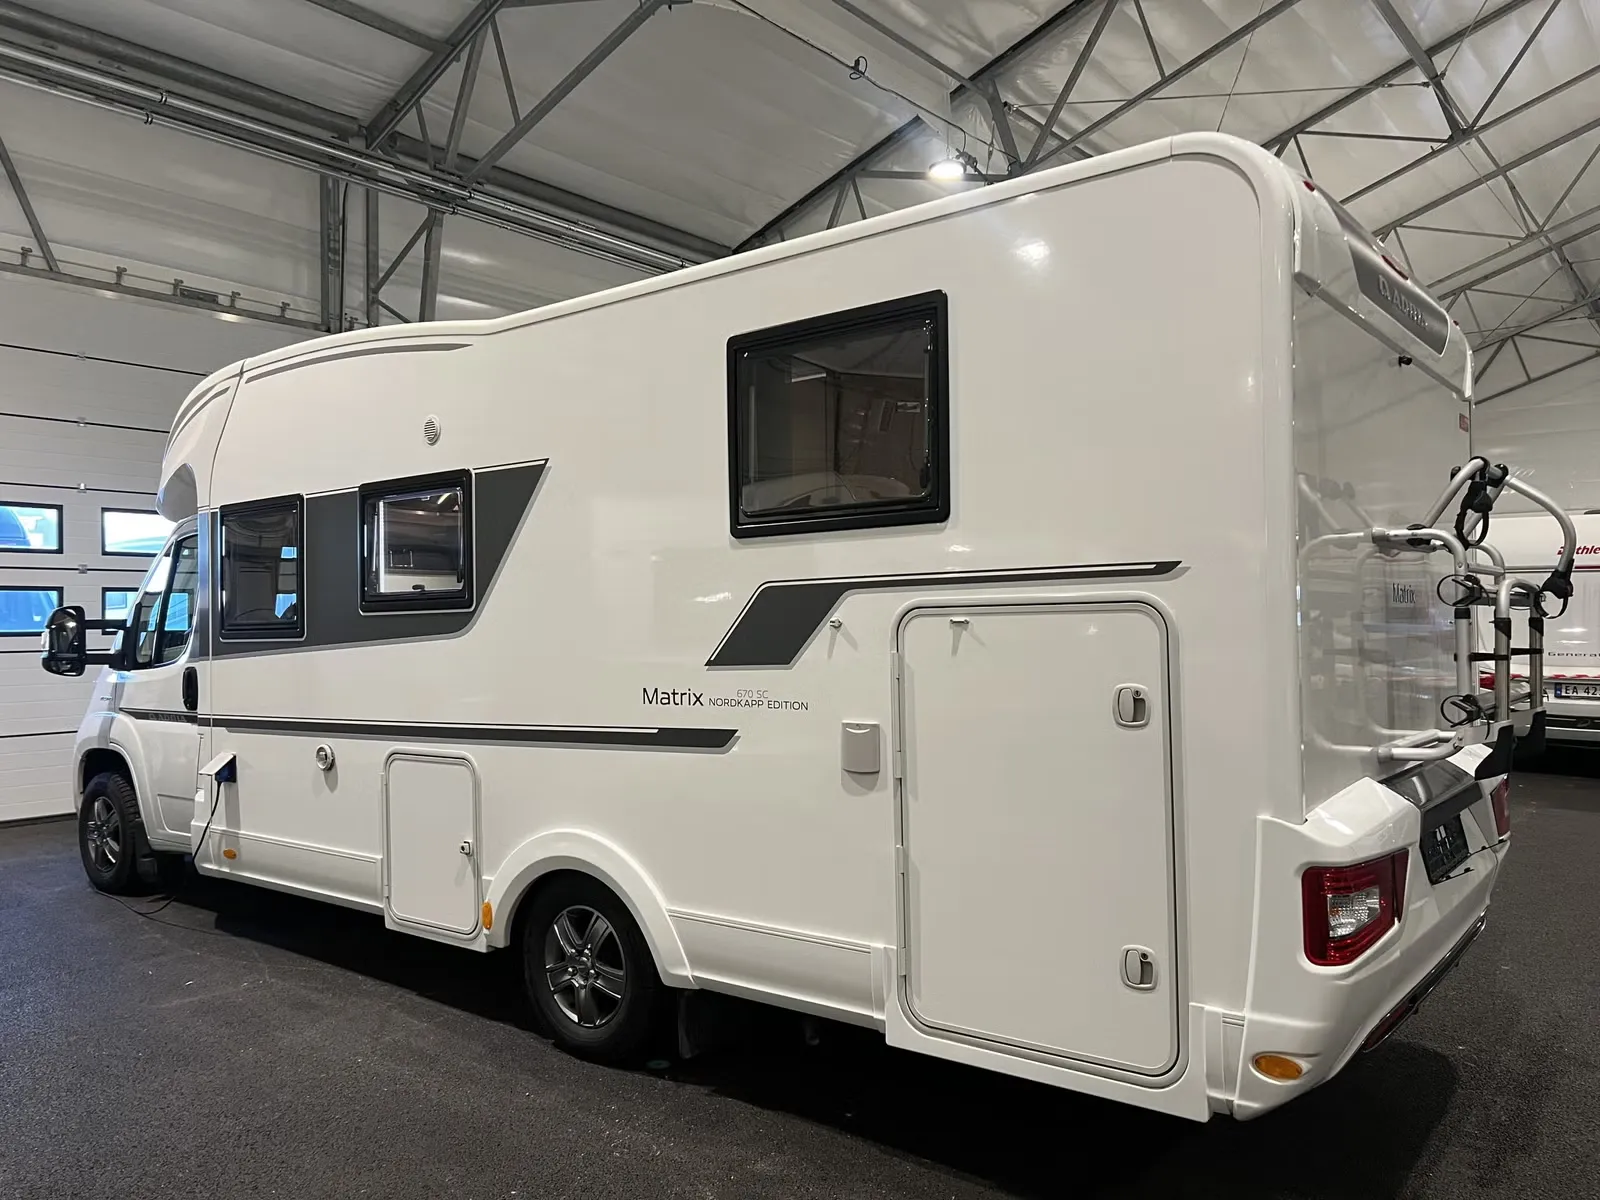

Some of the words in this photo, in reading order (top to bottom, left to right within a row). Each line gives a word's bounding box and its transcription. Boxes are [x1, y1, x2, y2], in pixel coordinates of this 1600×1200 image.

[1392, 582, 1416, 604] Matrix
[642, 687, 704, 706] Matrix
[736, 689, 754, 699] 670
[756, 690, 769, 699] SC
[1565, 685, 1579, 695] EA
[708, 697, 764, 709] NORDKAPP
[767, 700, 809, 711] EDITION
